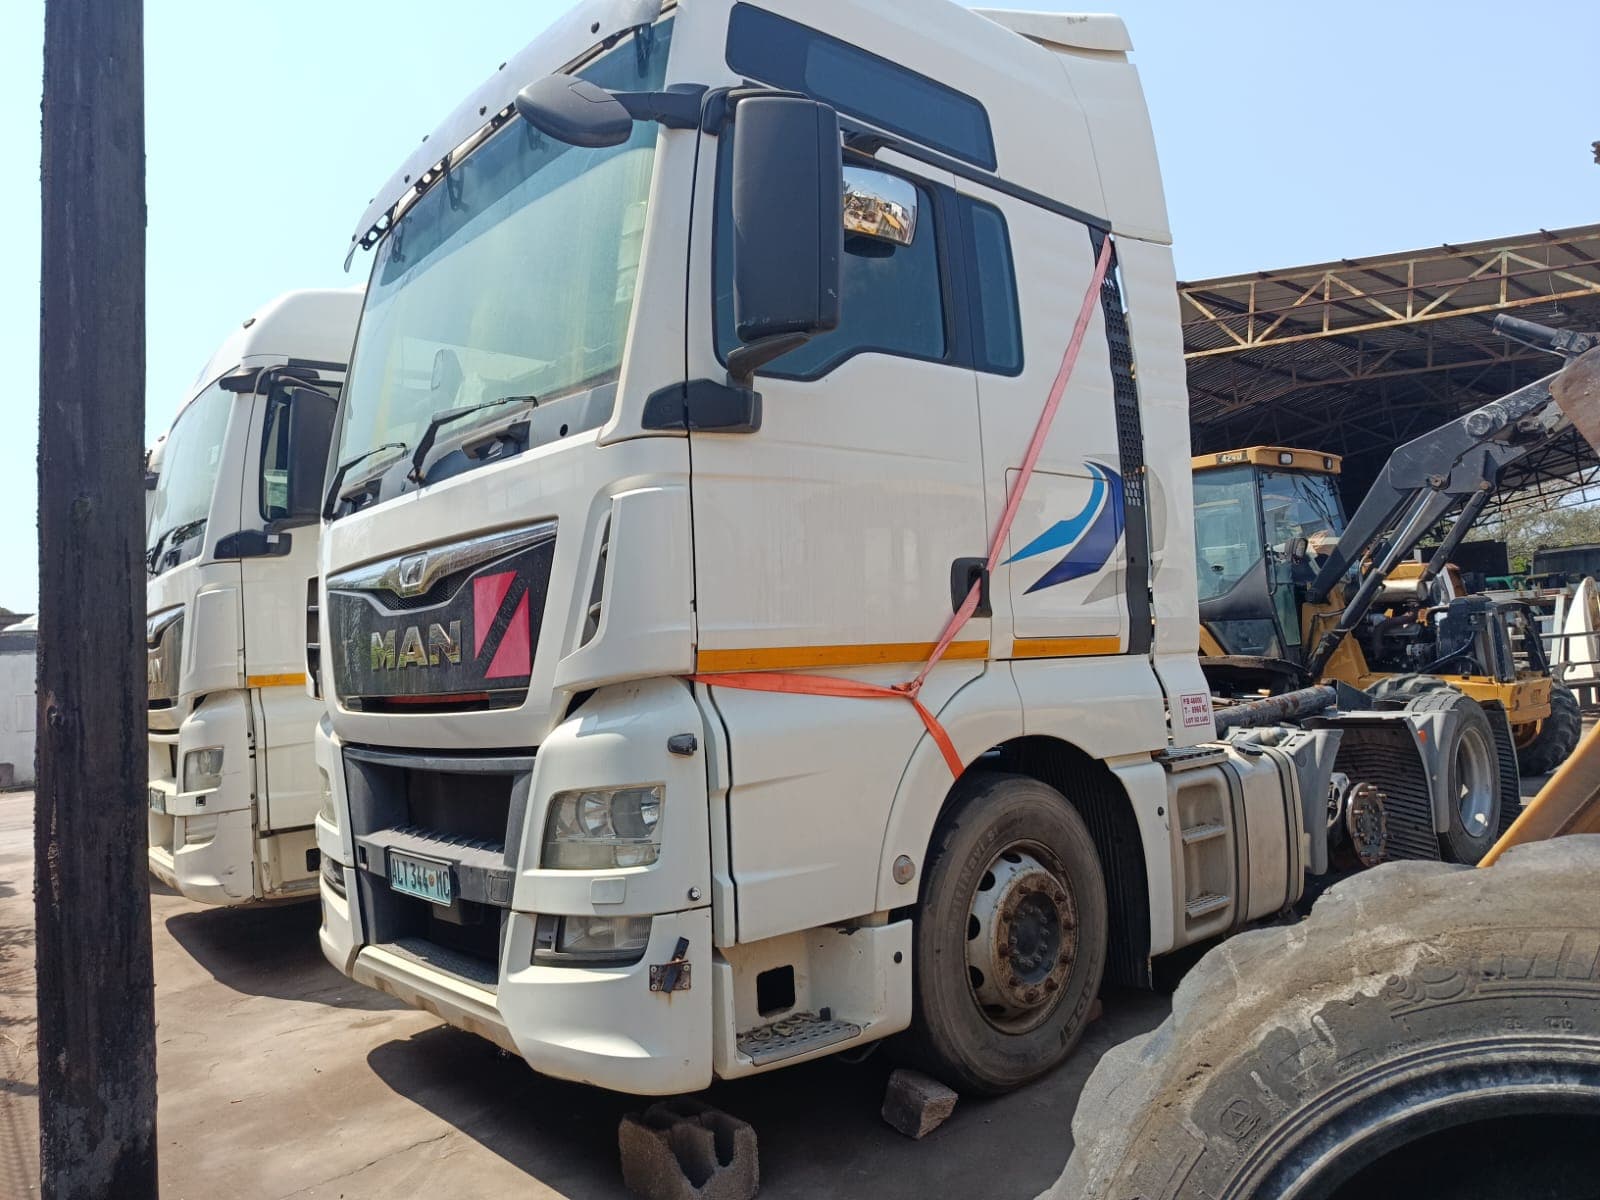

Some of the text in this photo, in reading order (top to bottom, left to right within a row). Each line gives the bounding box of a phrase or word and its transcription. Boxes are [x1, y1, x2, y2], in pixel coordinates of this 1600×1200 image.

[370, 620, 462, 672] MAN
[148, 657, 163, 683] AN
[391, 857, 408, 888] ALT
